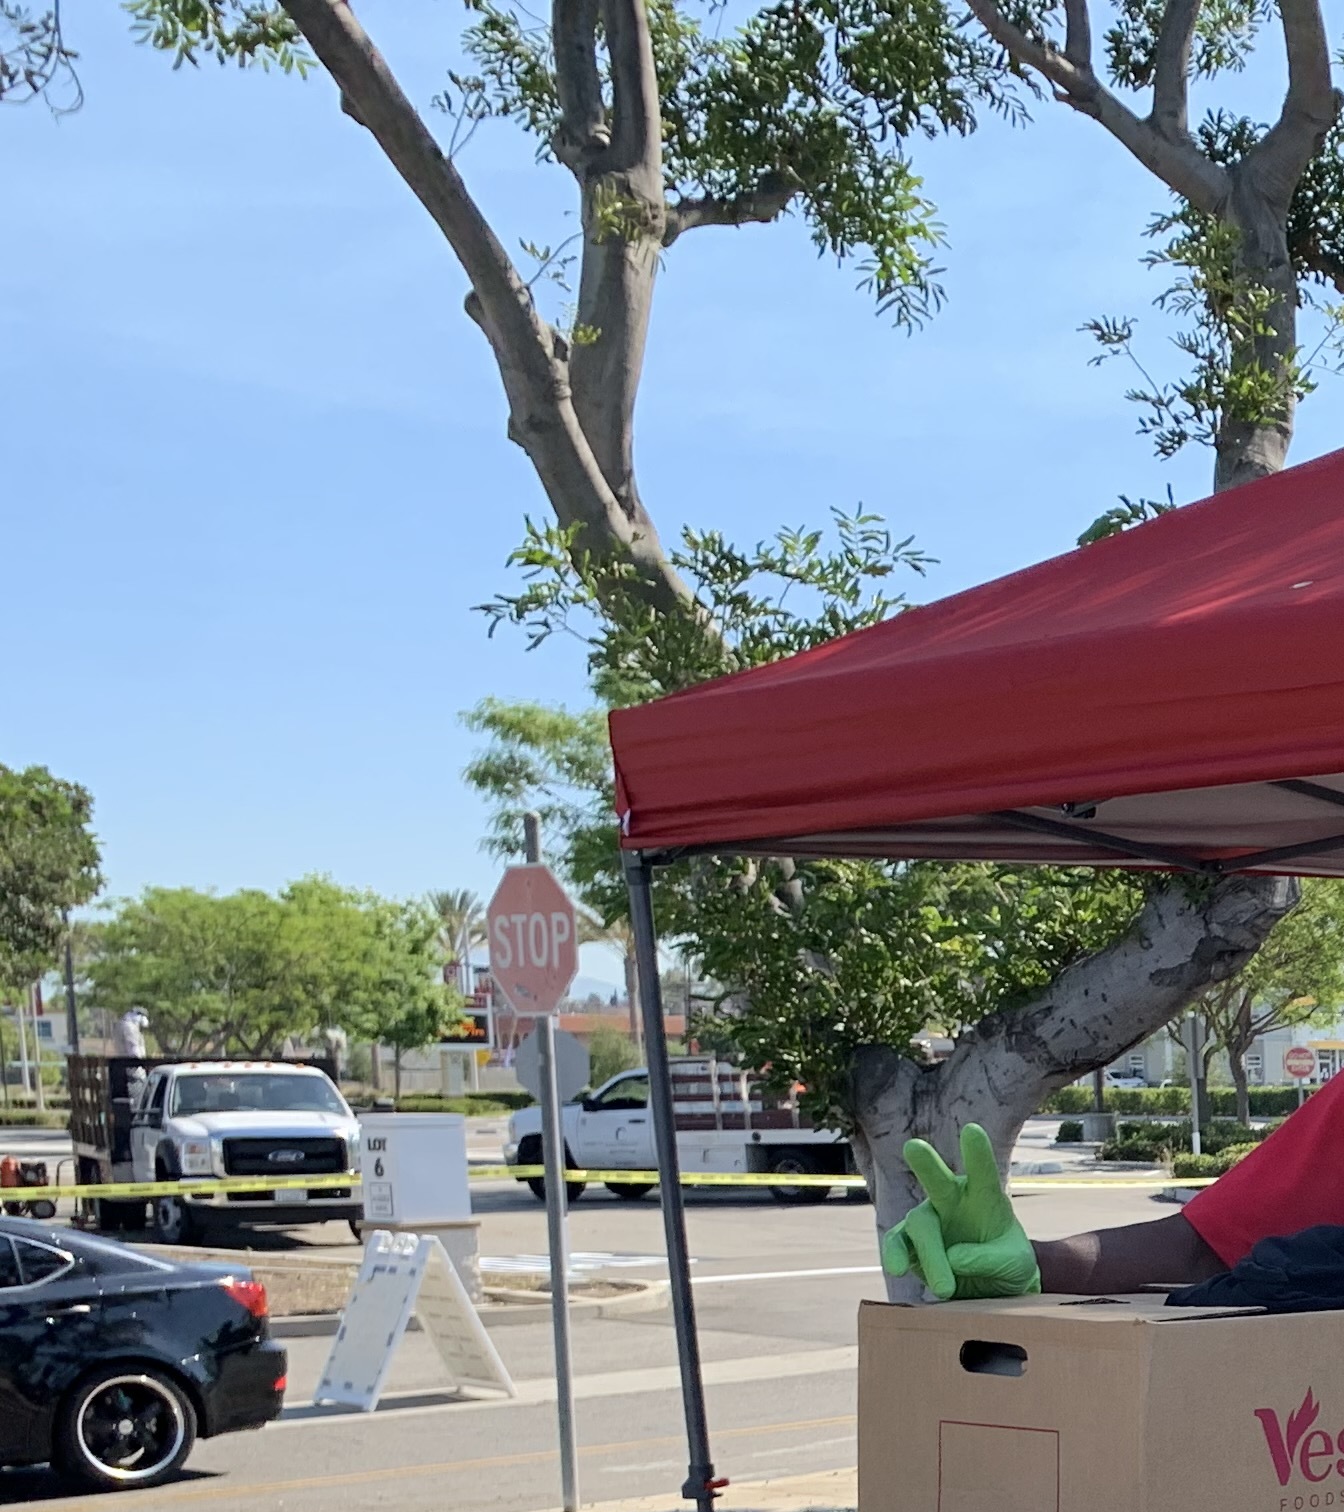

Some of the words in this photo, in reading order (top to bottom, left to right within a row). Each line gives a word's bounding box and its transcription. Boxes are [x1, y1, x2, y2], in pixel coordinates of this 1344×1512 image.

[494, 911, 570, 969] STOP
[367, 1137, 388, 1152] LOT
[374, 1157, 385, 1177] 6
